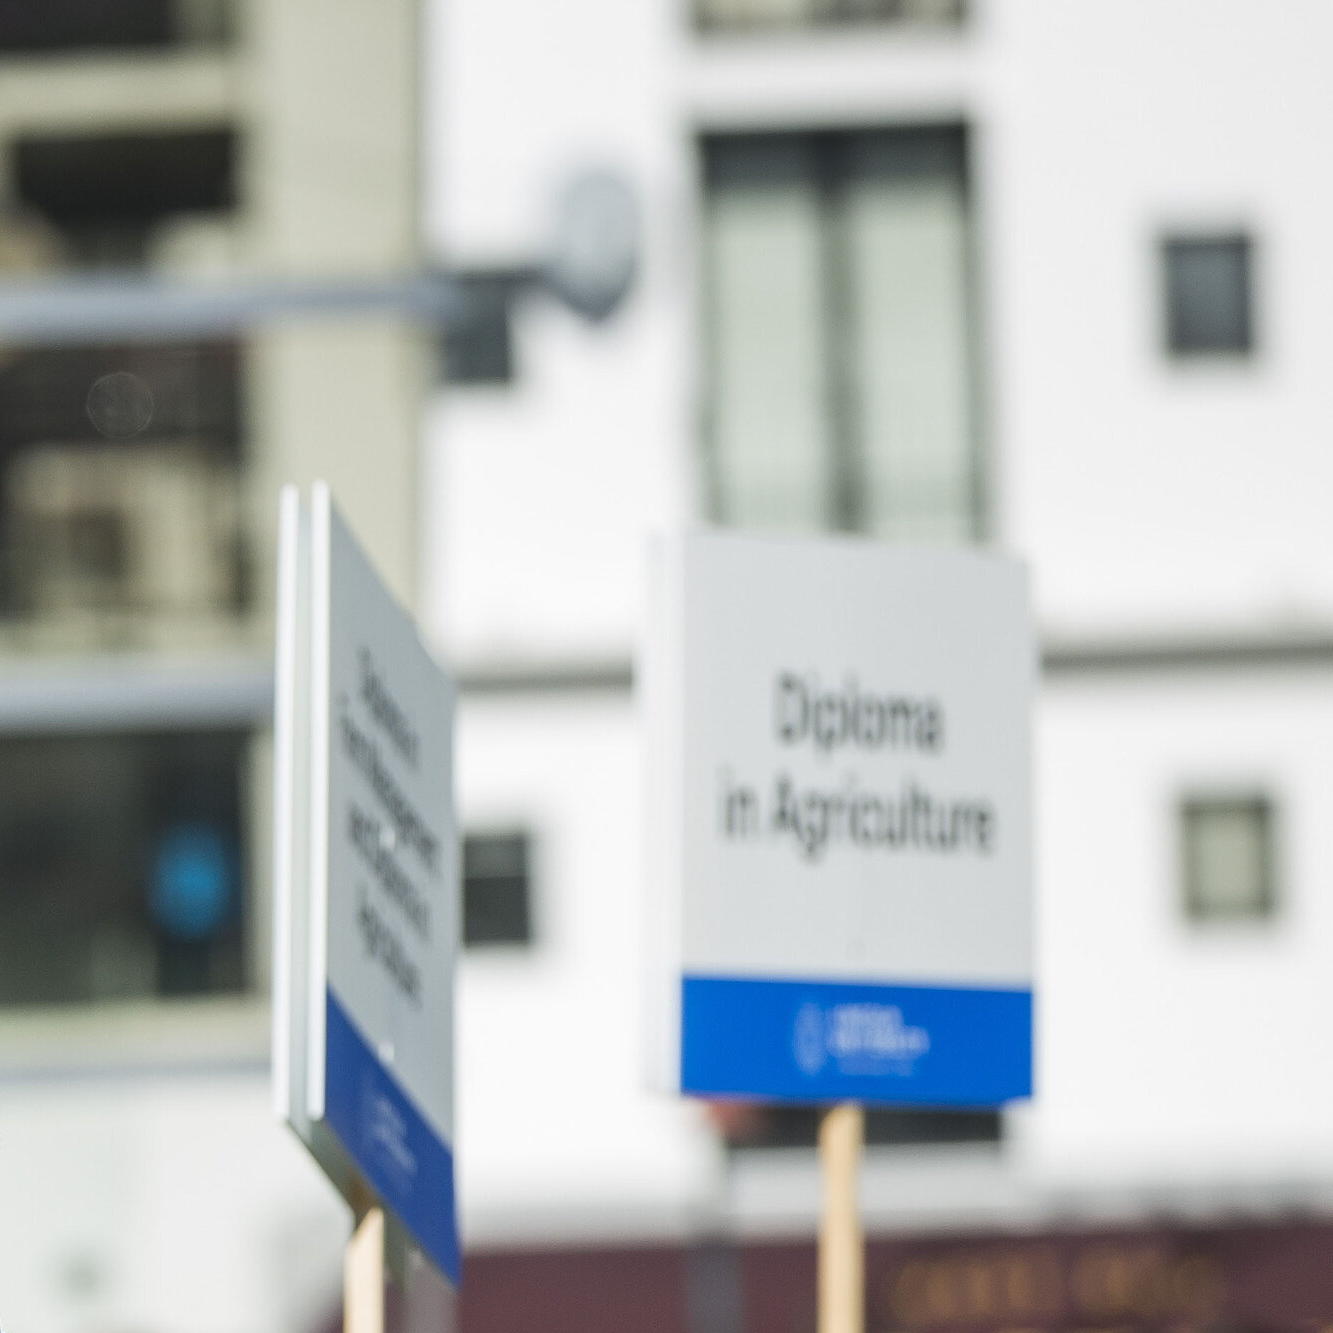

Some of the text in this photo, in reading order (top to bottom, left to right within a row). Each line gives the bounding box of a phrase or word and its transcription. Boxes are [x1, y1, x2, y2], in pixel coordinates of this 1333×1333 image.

[772, 669, 945, 758] Diploma
[719, 764, 997, 866] in Agriculture
